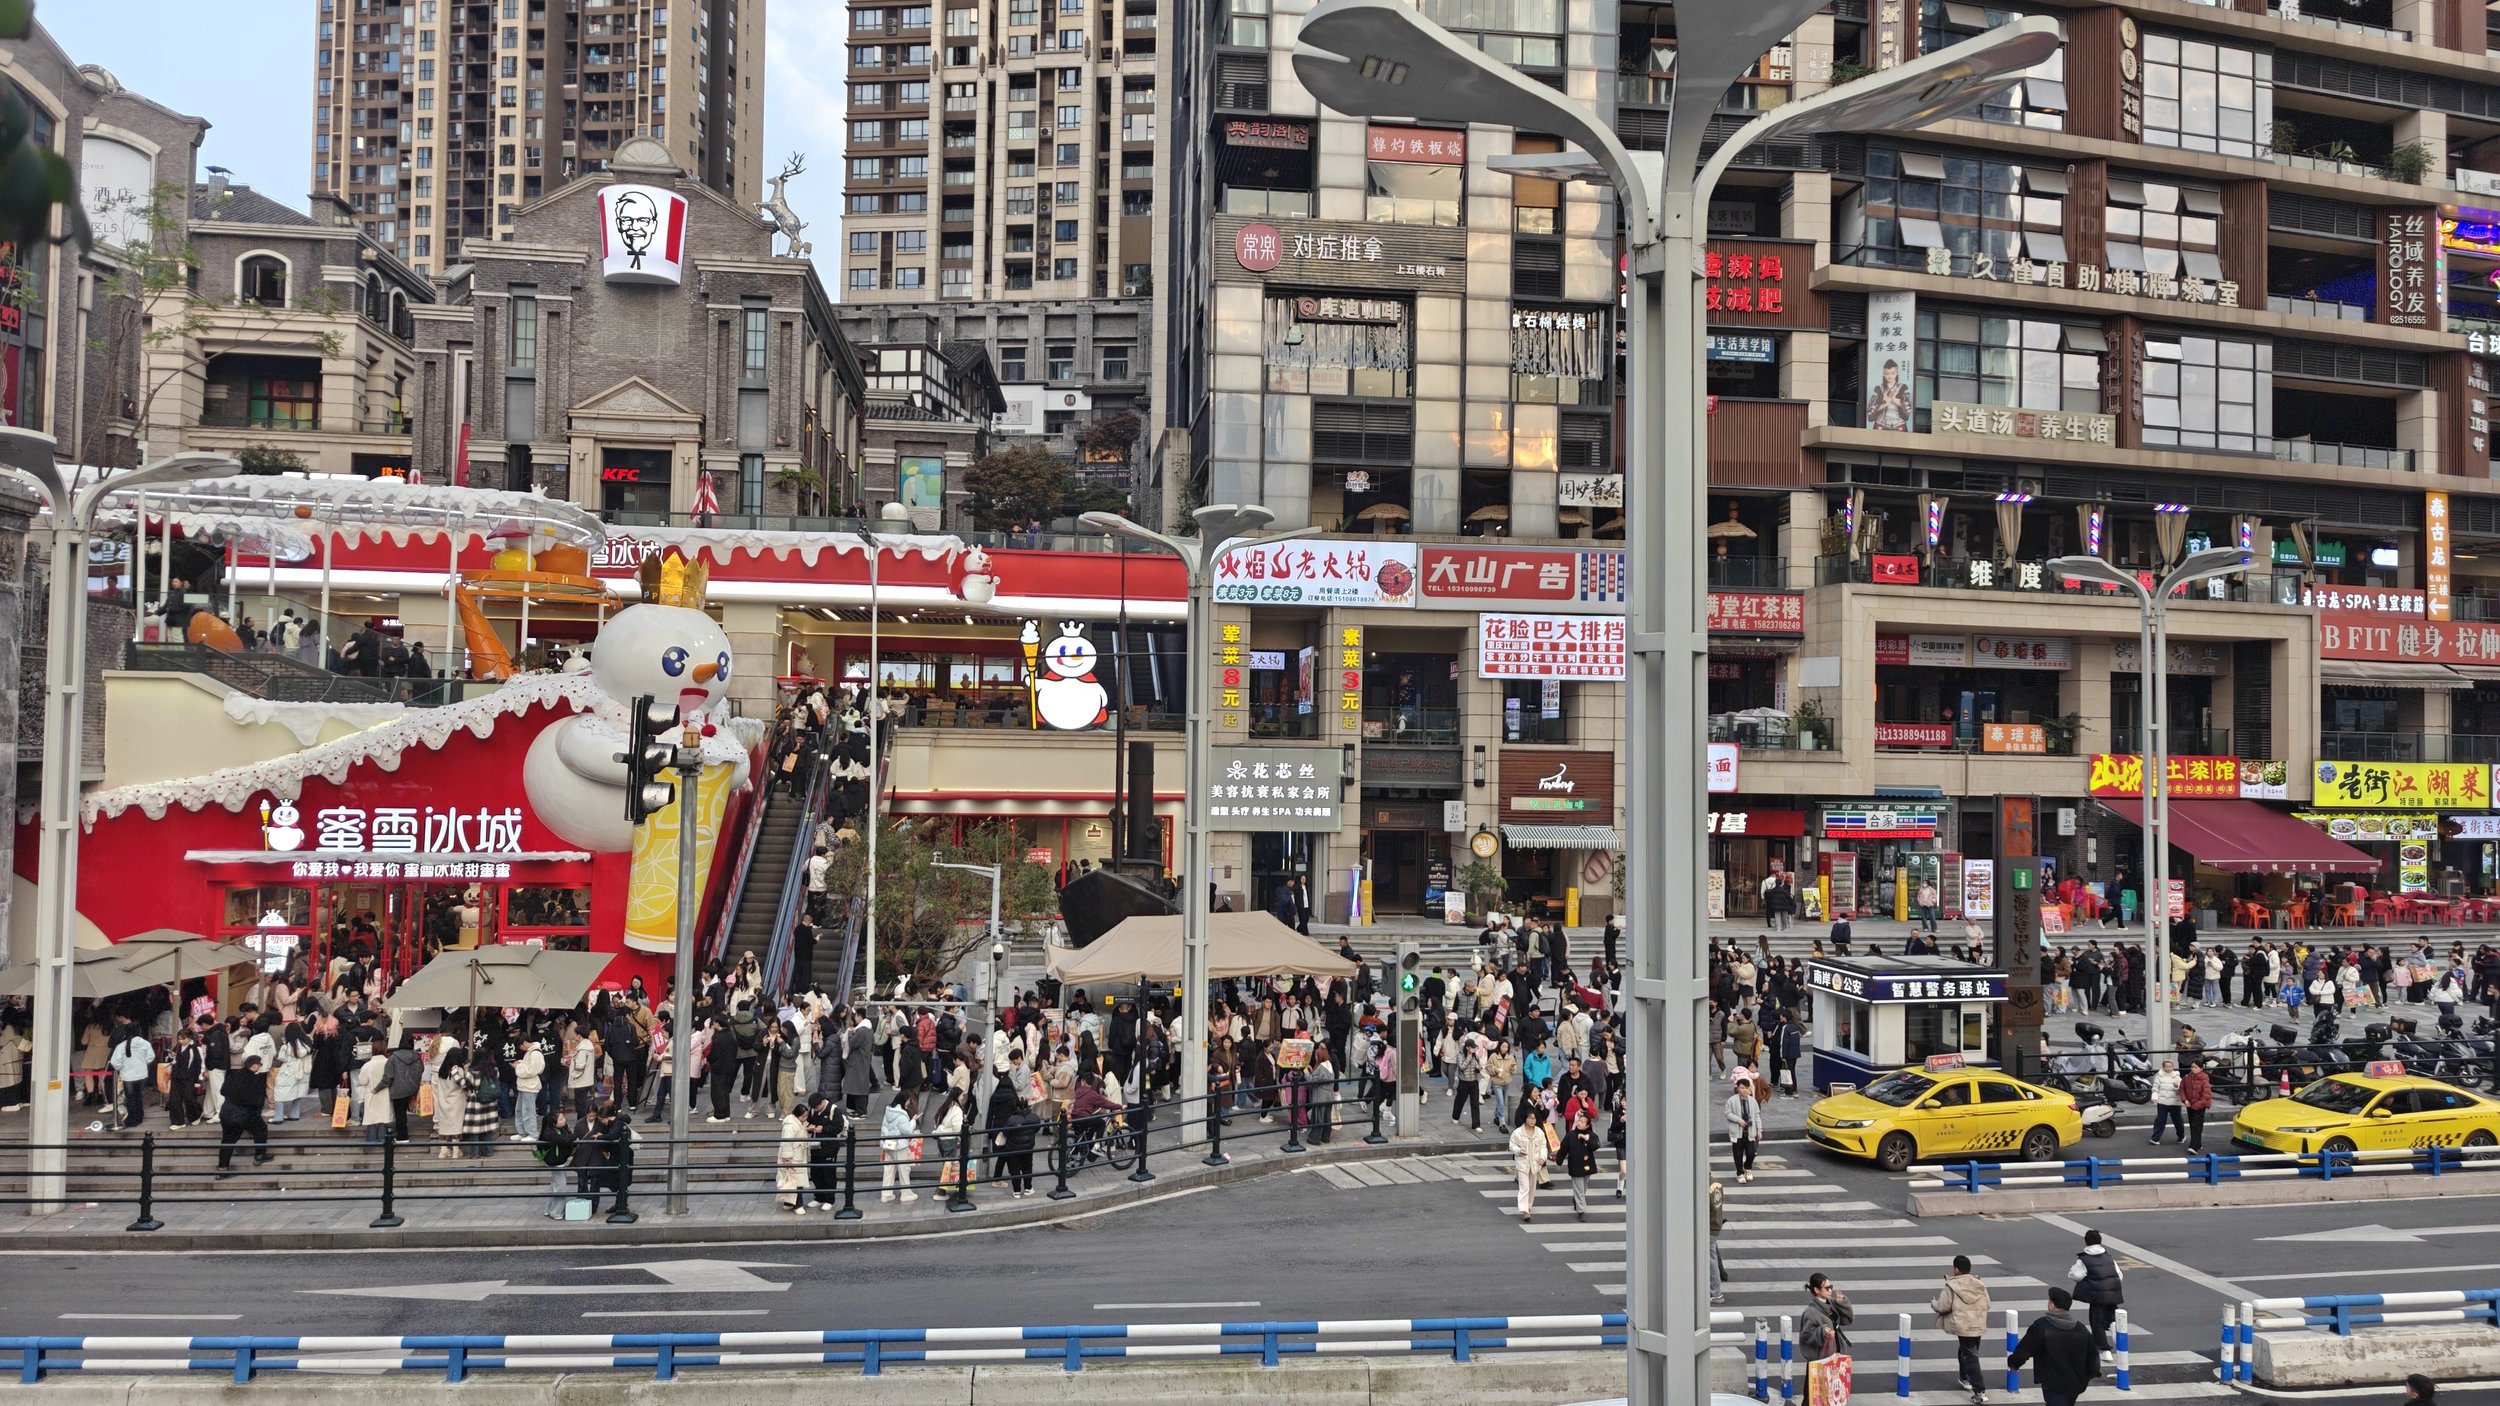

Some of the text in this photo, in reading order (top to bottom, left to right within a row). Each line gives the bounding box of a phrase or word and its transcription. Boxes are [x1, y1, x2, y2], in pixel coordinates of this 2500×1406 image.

[1229, 121, 1291, 139] 典韵阁
[1293, 233, 1384, 261] 对症推拿
[1395, 264, 1446, 277] 上五楼右转
[2389, 215, 2403, 312] HAIROLOGY
[2404, 215, 2425, 313] 丝域养发
[1973, 252, 2240, 307] 久雀自助棋牌茶室
[1319, 297, 1401, 320] 库迪咖啡
[1881, 312, 1903, 322] 养头
[2389, 315, 2426, 324] 62516555
[1880, 326, 1903, 337] 养发
[1716, 336, 1771, 352] 生活美学馆
[1874, 341, 1909, 352] 养全身
[1941, 406, 2013, 435] 头道汤
[2040, 415, 2110, 443] 养生馆
[602, 468, 640, 481] KFC
[2429, 498, 2447, 566] 泰古龙
[1428, 556, 1571, 590] 大山广告
[1217, 585, 1257, 600] 素菜3元
[1261, 586, 1301, 601] 荤菜8元
[2208, 577, 2226, 599] 馆
[2428, 584, 2450, 597] 三楼
[1485, 618, 1625, 641] 花脸巴大排档
[1753, 620, 1801, 630] 15823706249
[1876, 639, 1907, 651] 利彩票
[2347, 626, 2391, 652] FIT
[1486, 652, 1529, 662] 家常小炒
[1221, 624, 1241, 727] 荤菜8元起
[1341, 627, 1361, 729] 素菜3元起
[1558, 666, 1622, 677] 万州特色烤鱼
[1991, 727, 2044, 743] 泰瑞祺
[1252, 762, 1316, 779] 花芯丝
[1211, 784, 1331, 800] 美容抗衰私家会所
[1231, 806, 1250, 816] 头疗
[1252, 806, 1270, 816] 养生
[1272, 806, 1292, 816] SPA
[1869, 814, 1894, 828] 合家
[316, 805, 523, 854] 蜜雪冰城
[292, 862, 341, 878] 你爱我
[353, 862, 400, 878] 我爱你
[1813, 969, 1863, 995] 南岸 公安
[1891, 980, 1991, 999] 智慧警务驿站
